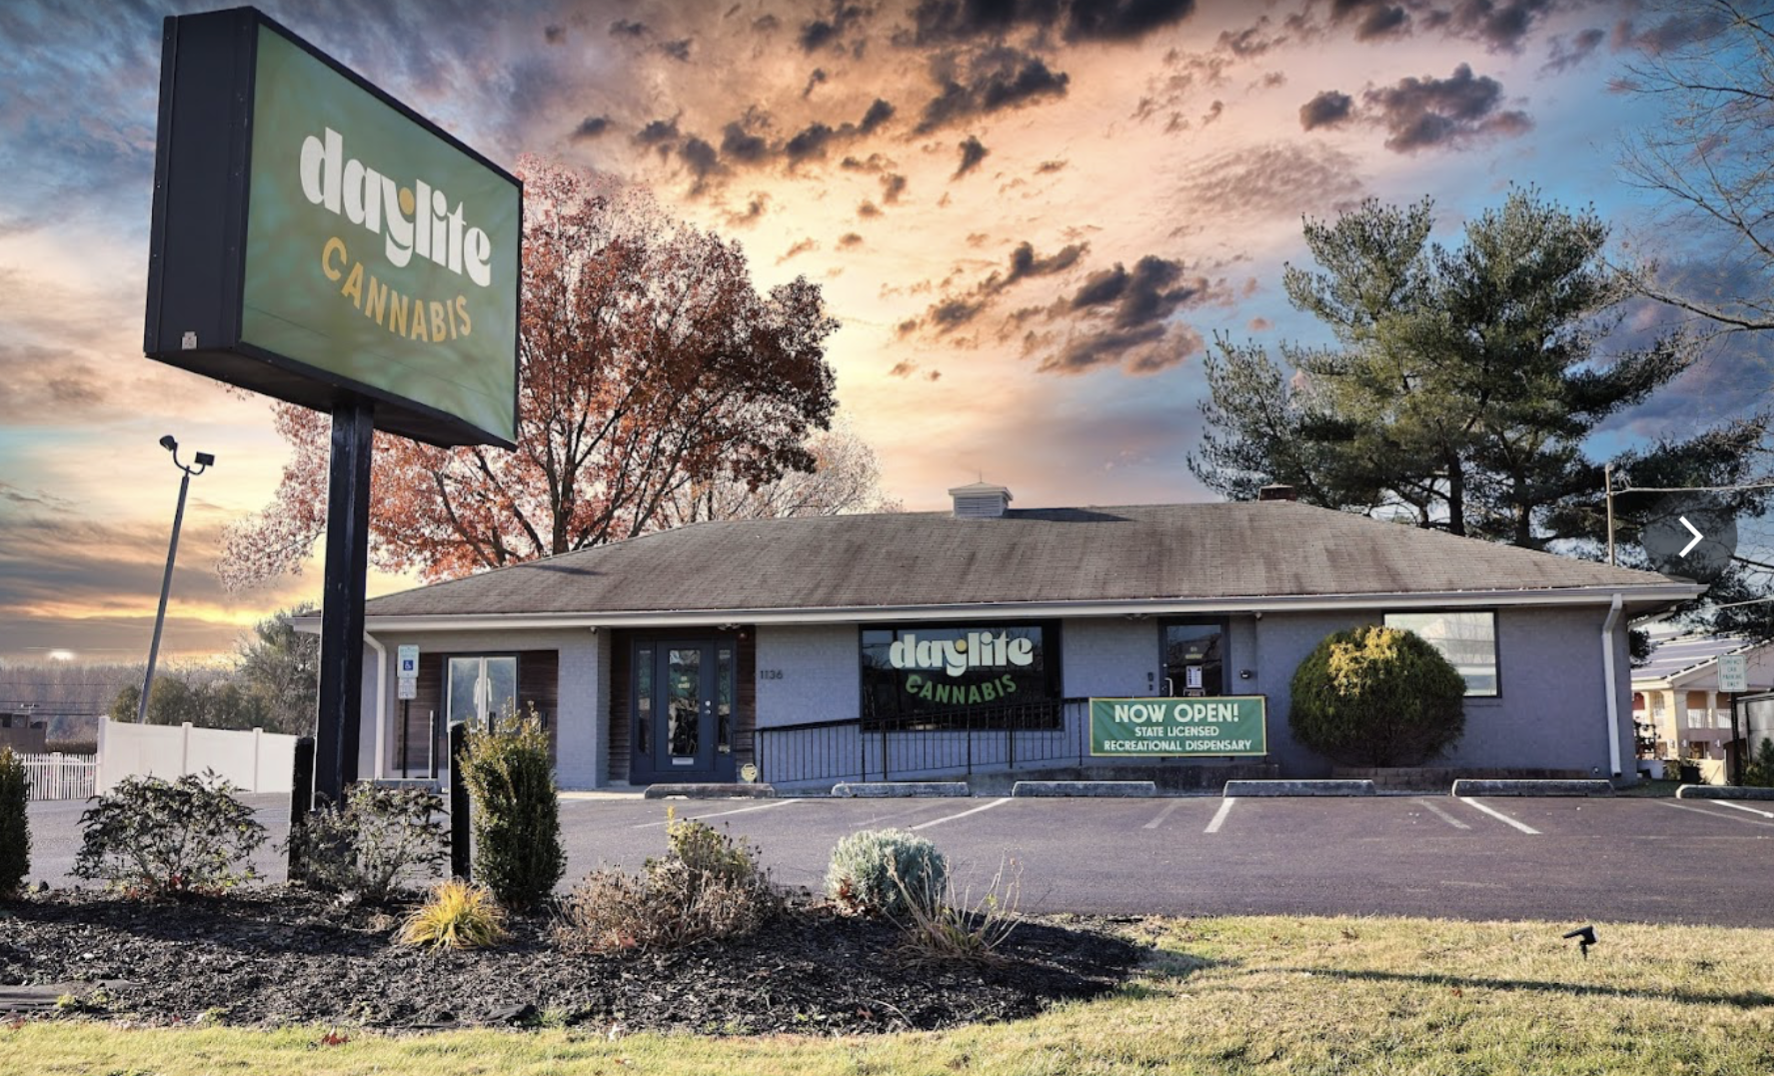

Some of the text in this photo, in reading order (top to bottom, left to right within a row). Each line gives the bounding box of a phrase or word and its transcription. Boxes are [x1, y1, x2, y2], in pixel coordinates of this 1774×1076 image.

[300, 127, 491, 287] daylite
[322, 236, 471, 343] CANNABIS
[889, 630, 1033, 677] daylite
[760, 669, 783, 680] 1136
[905, 674, 1017, 705] CANNABIS
[1114, 703, 1239, 723] NOW OPEN!
[1134, 726, 1220, 737] STATE LICENSED
[1104, 739, 1252, 751] RECREATIONAL DISPENSARY
